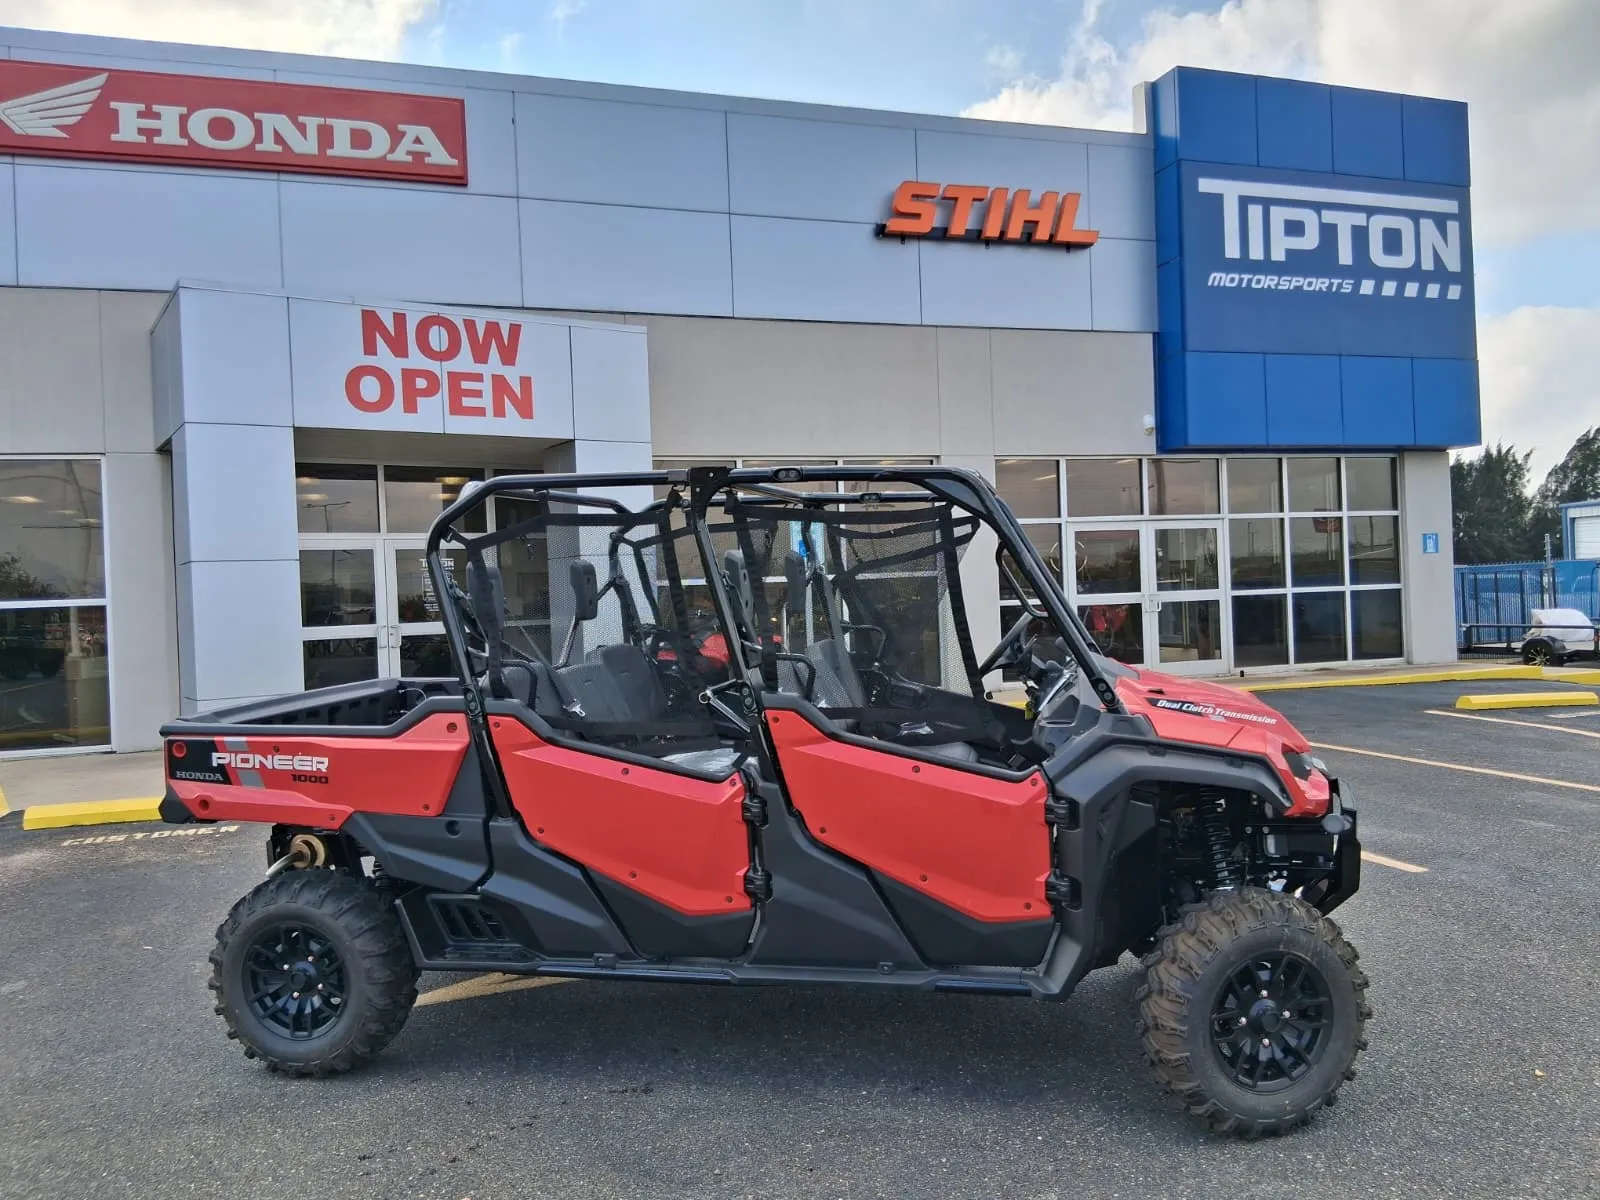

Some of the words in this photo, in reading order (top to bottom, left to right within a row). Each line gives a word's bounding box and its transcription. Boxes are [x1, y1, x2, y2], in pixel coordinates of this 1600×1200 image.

[109, 101, 459, 166] HONDA
[885, 180, 1100, 246] STIHL
[1198, 177, 1462, 273] TIPTON
[1207, 272, 1355, 293] MOTORSPORTS
[360, 309, 522, 367] NOW
[344, 364, 535, 420] OPEN
[1156, 699, 1181, 709] Dual
[1182, 702, 1215, 714] Clutch
[1214, 707, 1277, 725] Transmission
[211, 751, 329, 772] PIONEER
[175, 770, 225, 781] HONDA
[291, 774, 329, 784] 1000
[61, 825, 241, 847] CUSTOMER
